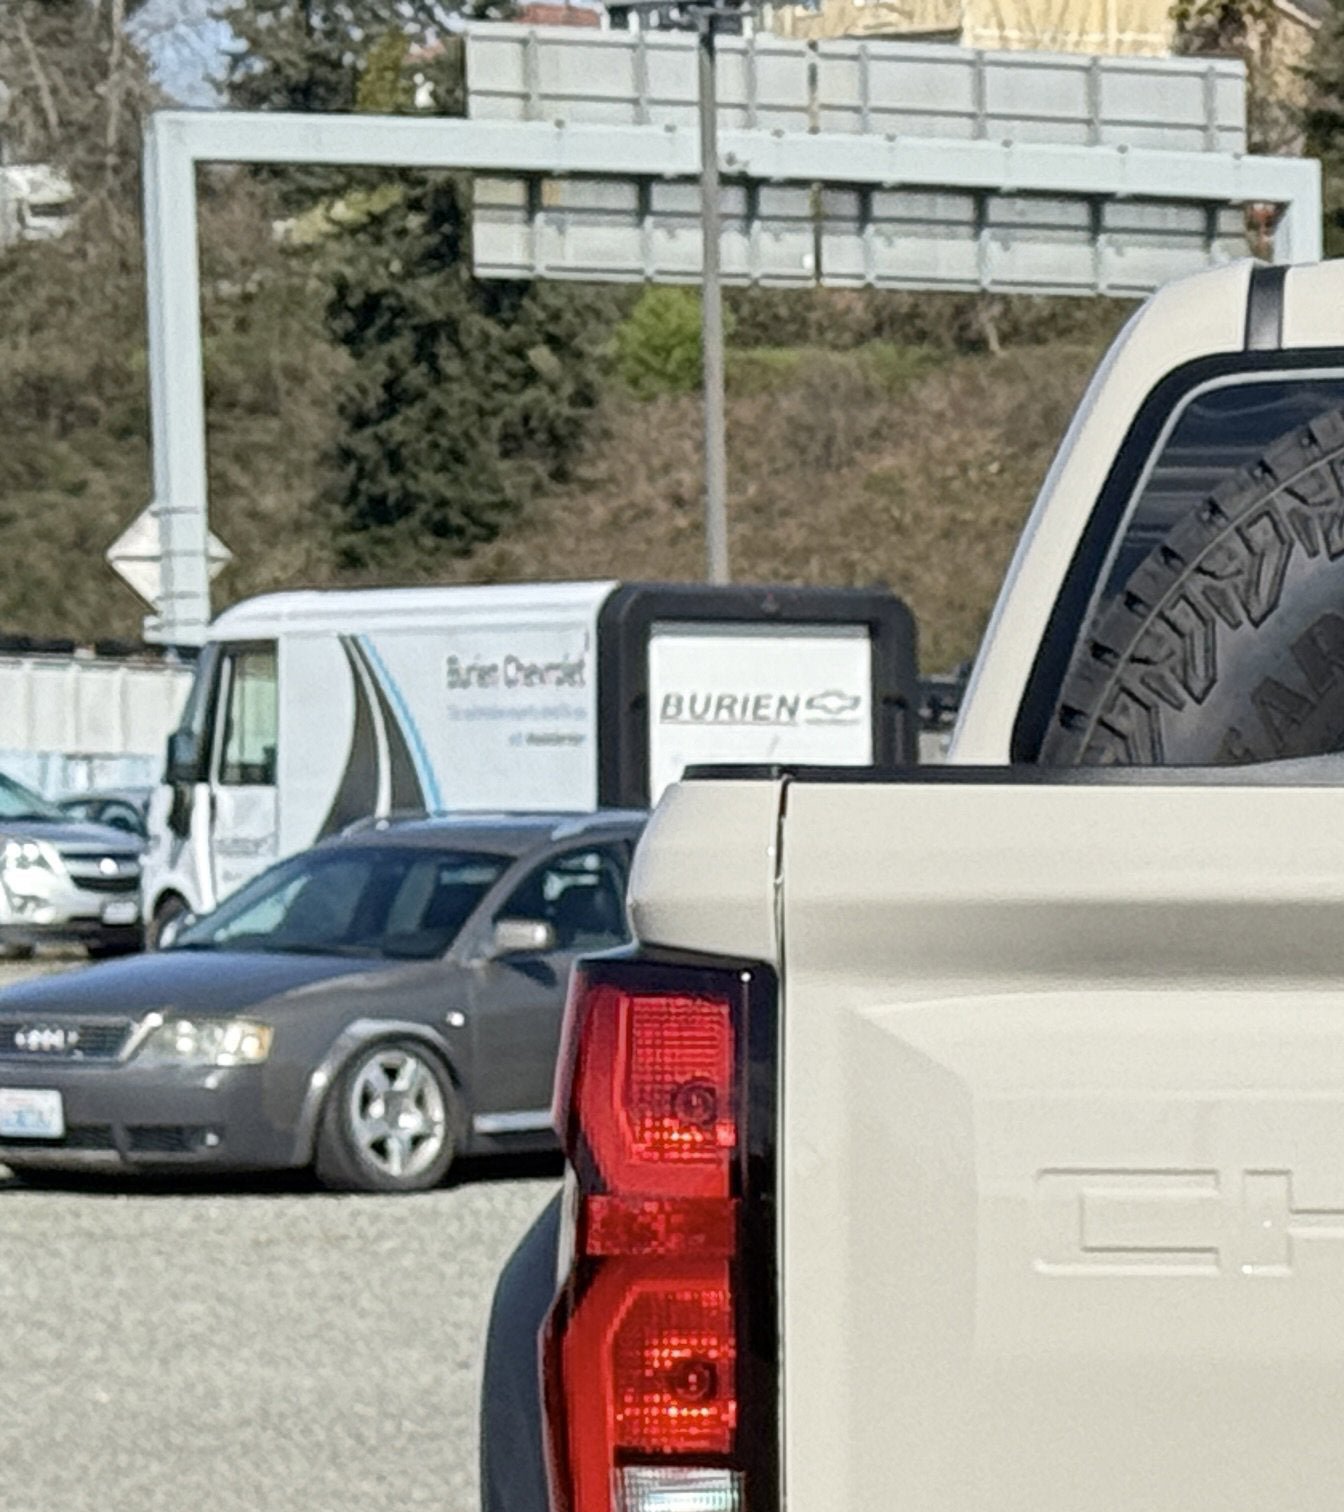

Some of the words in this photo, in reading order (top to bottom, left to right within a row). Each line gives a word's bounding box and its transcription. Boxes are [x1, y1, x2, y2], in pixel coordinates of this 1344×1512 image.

[446, 653, 499, 690] Burien
[503, 652, 587, 690] Chevrolet
[659, 692, 800, 722] BURIEN
